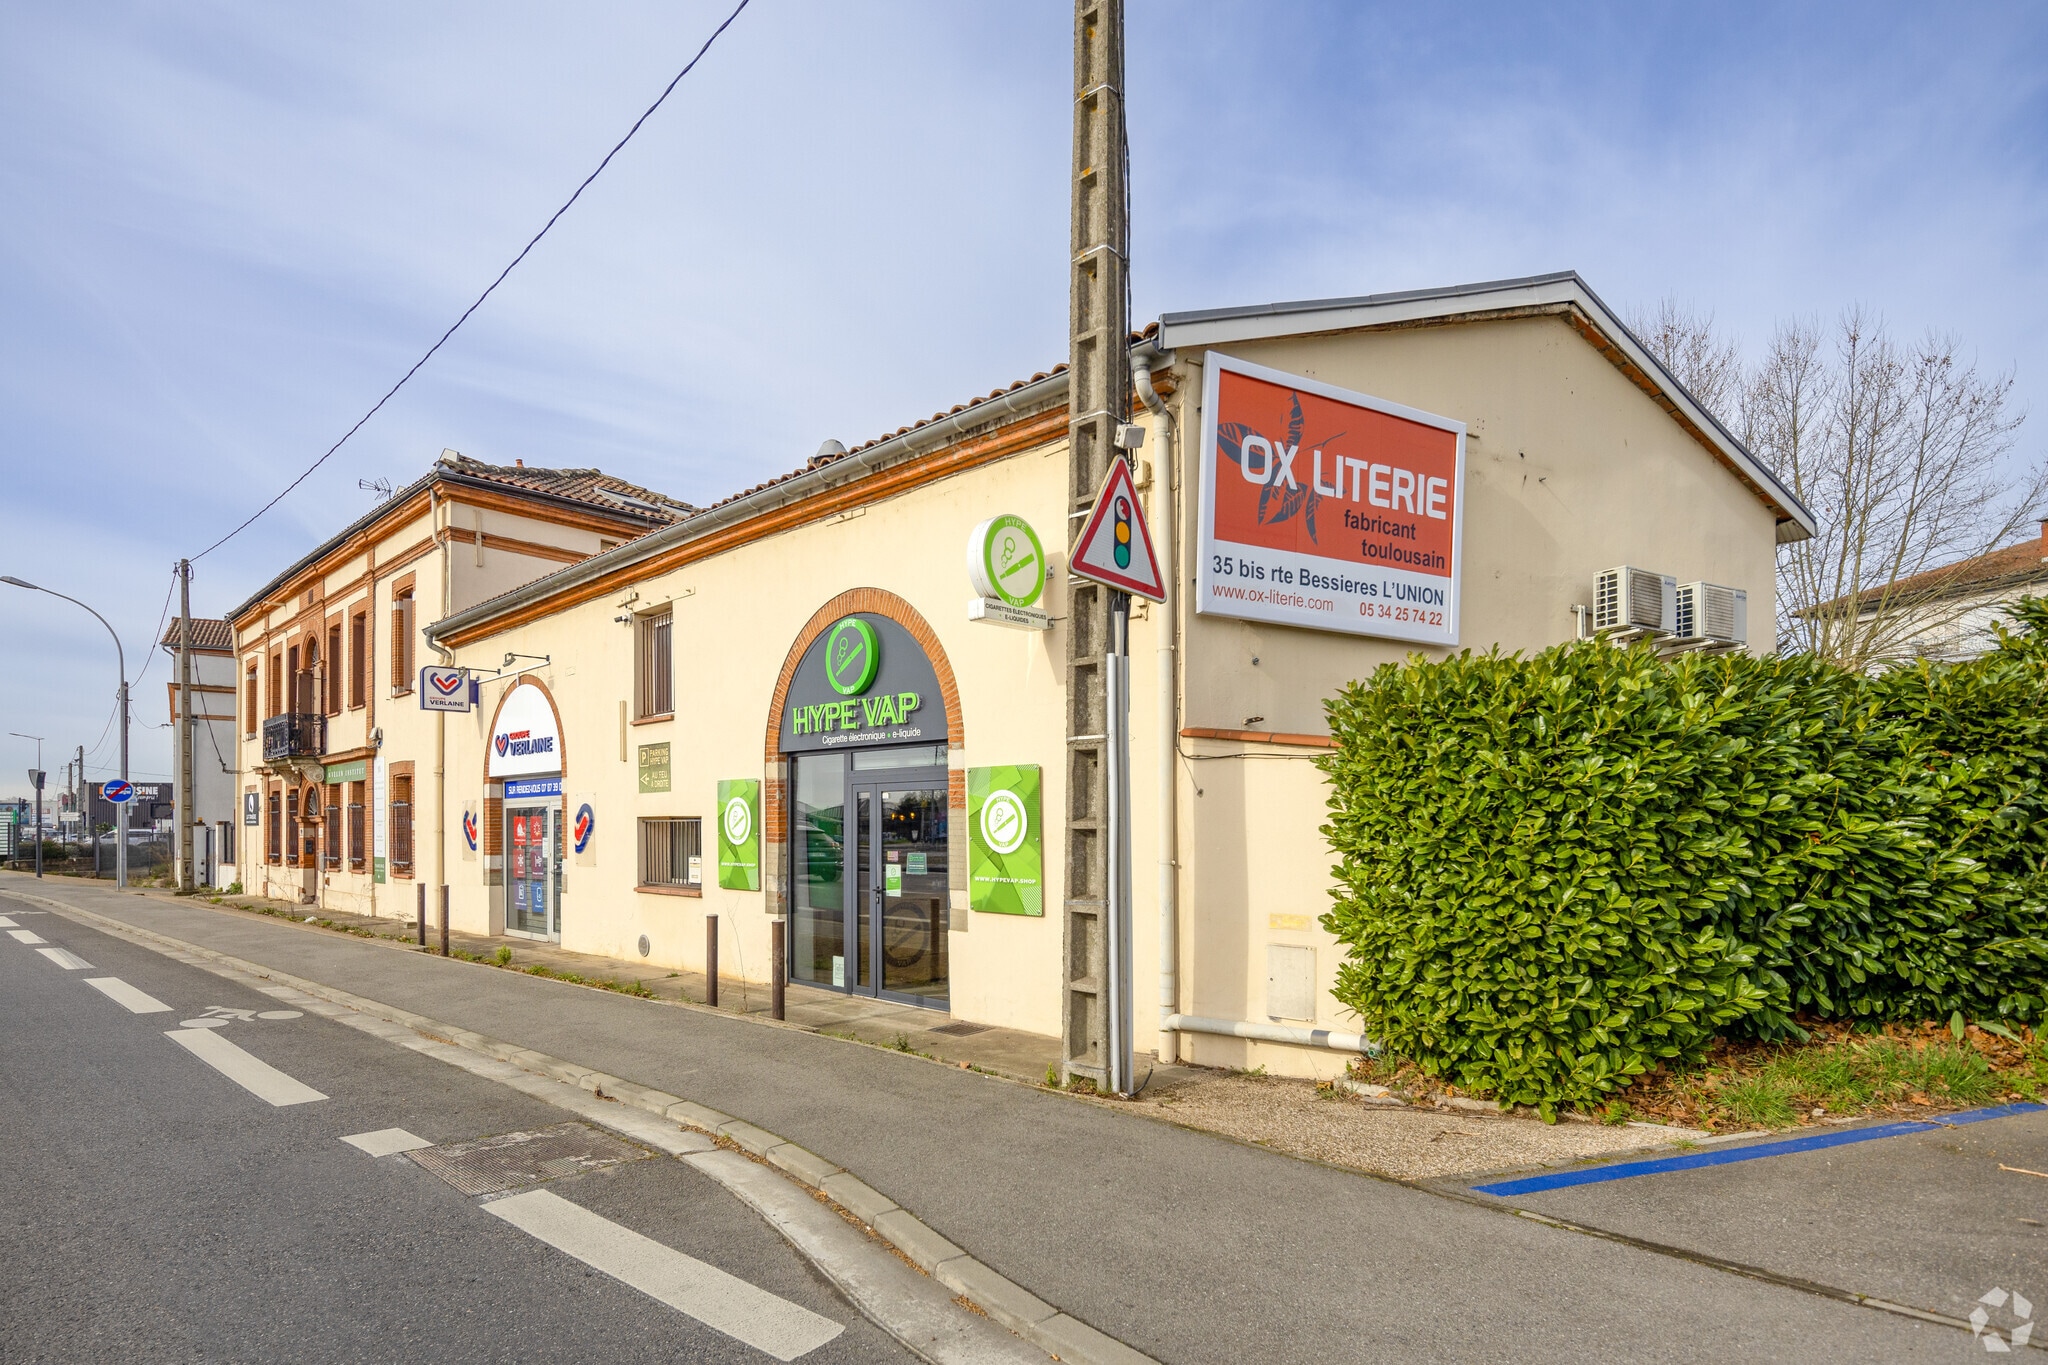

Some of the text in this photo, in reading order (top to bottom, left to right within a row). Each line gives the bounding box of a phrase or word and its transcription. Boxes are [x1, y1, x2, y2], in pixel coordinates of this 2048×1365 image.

[1241, 434, 1448, 520] OX LITERIE
[1005, 517, 1027, 532] HYPE
[1344, 509, 1416, 540] fabricant
[1361, 539, 1445, 569] toulousain
[1213, 555, 1444, 606] 35 bis rte Bessieres L'UNION
[1009, 597, 1025, 607] VAP
[1212, 585, 1443, 626] www.ox-literie.com 05 34 25 74 22
[840, 619, 856, 630] HYPE
[842, 685, 855, 694] VAP
[430, 699, 465, 707] VERLAINE
[792, 692, 921, 735] HYPE VAP
[510, 736, 553, 756] VERLAINE
[822, 727, 921, 746] Cigarette électronique e-liquide
[975, 876, 1037, 884] WWW.HYPEVAP.SHOP
